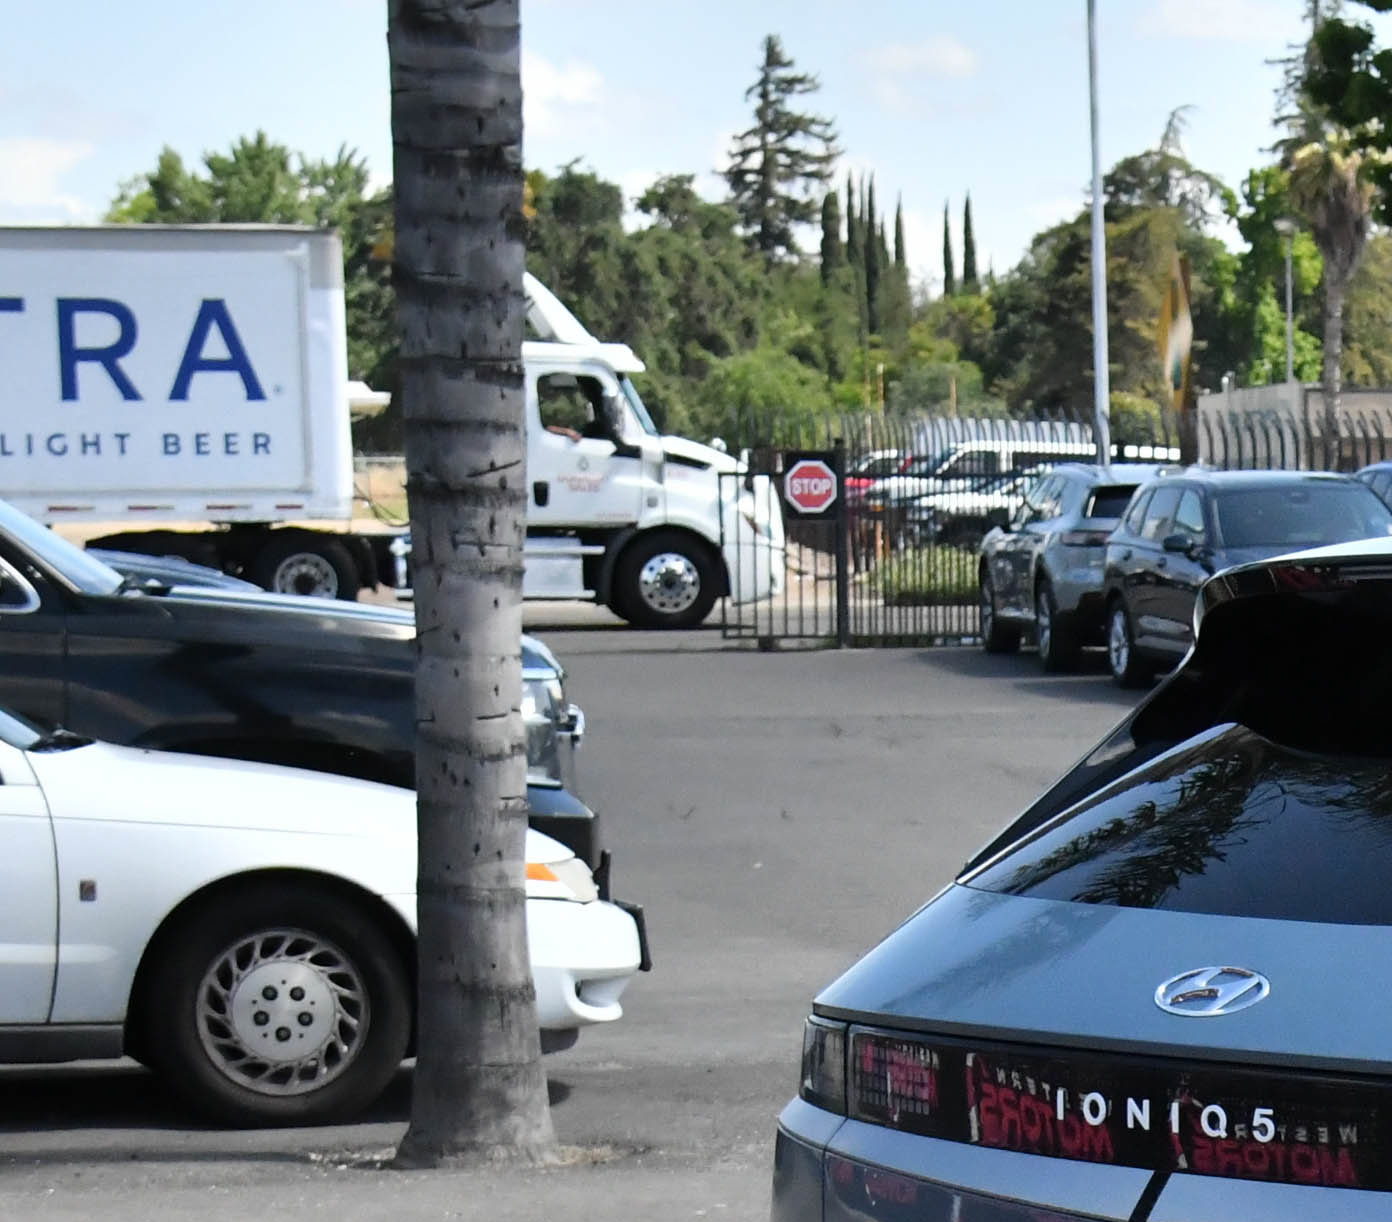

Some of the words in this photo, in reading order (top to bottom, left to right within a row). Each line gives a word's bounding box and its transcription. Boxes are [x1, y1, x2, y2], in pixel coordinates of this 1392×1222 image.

[0, 433, 131, 456] LIGHT
[162, 433, 272, 456] BEER
[791, 478, 831, 495] STOP
[1056, 1087, 1227, 1139] IONIQ
[1252, 1108, 1276, 1143] 5
